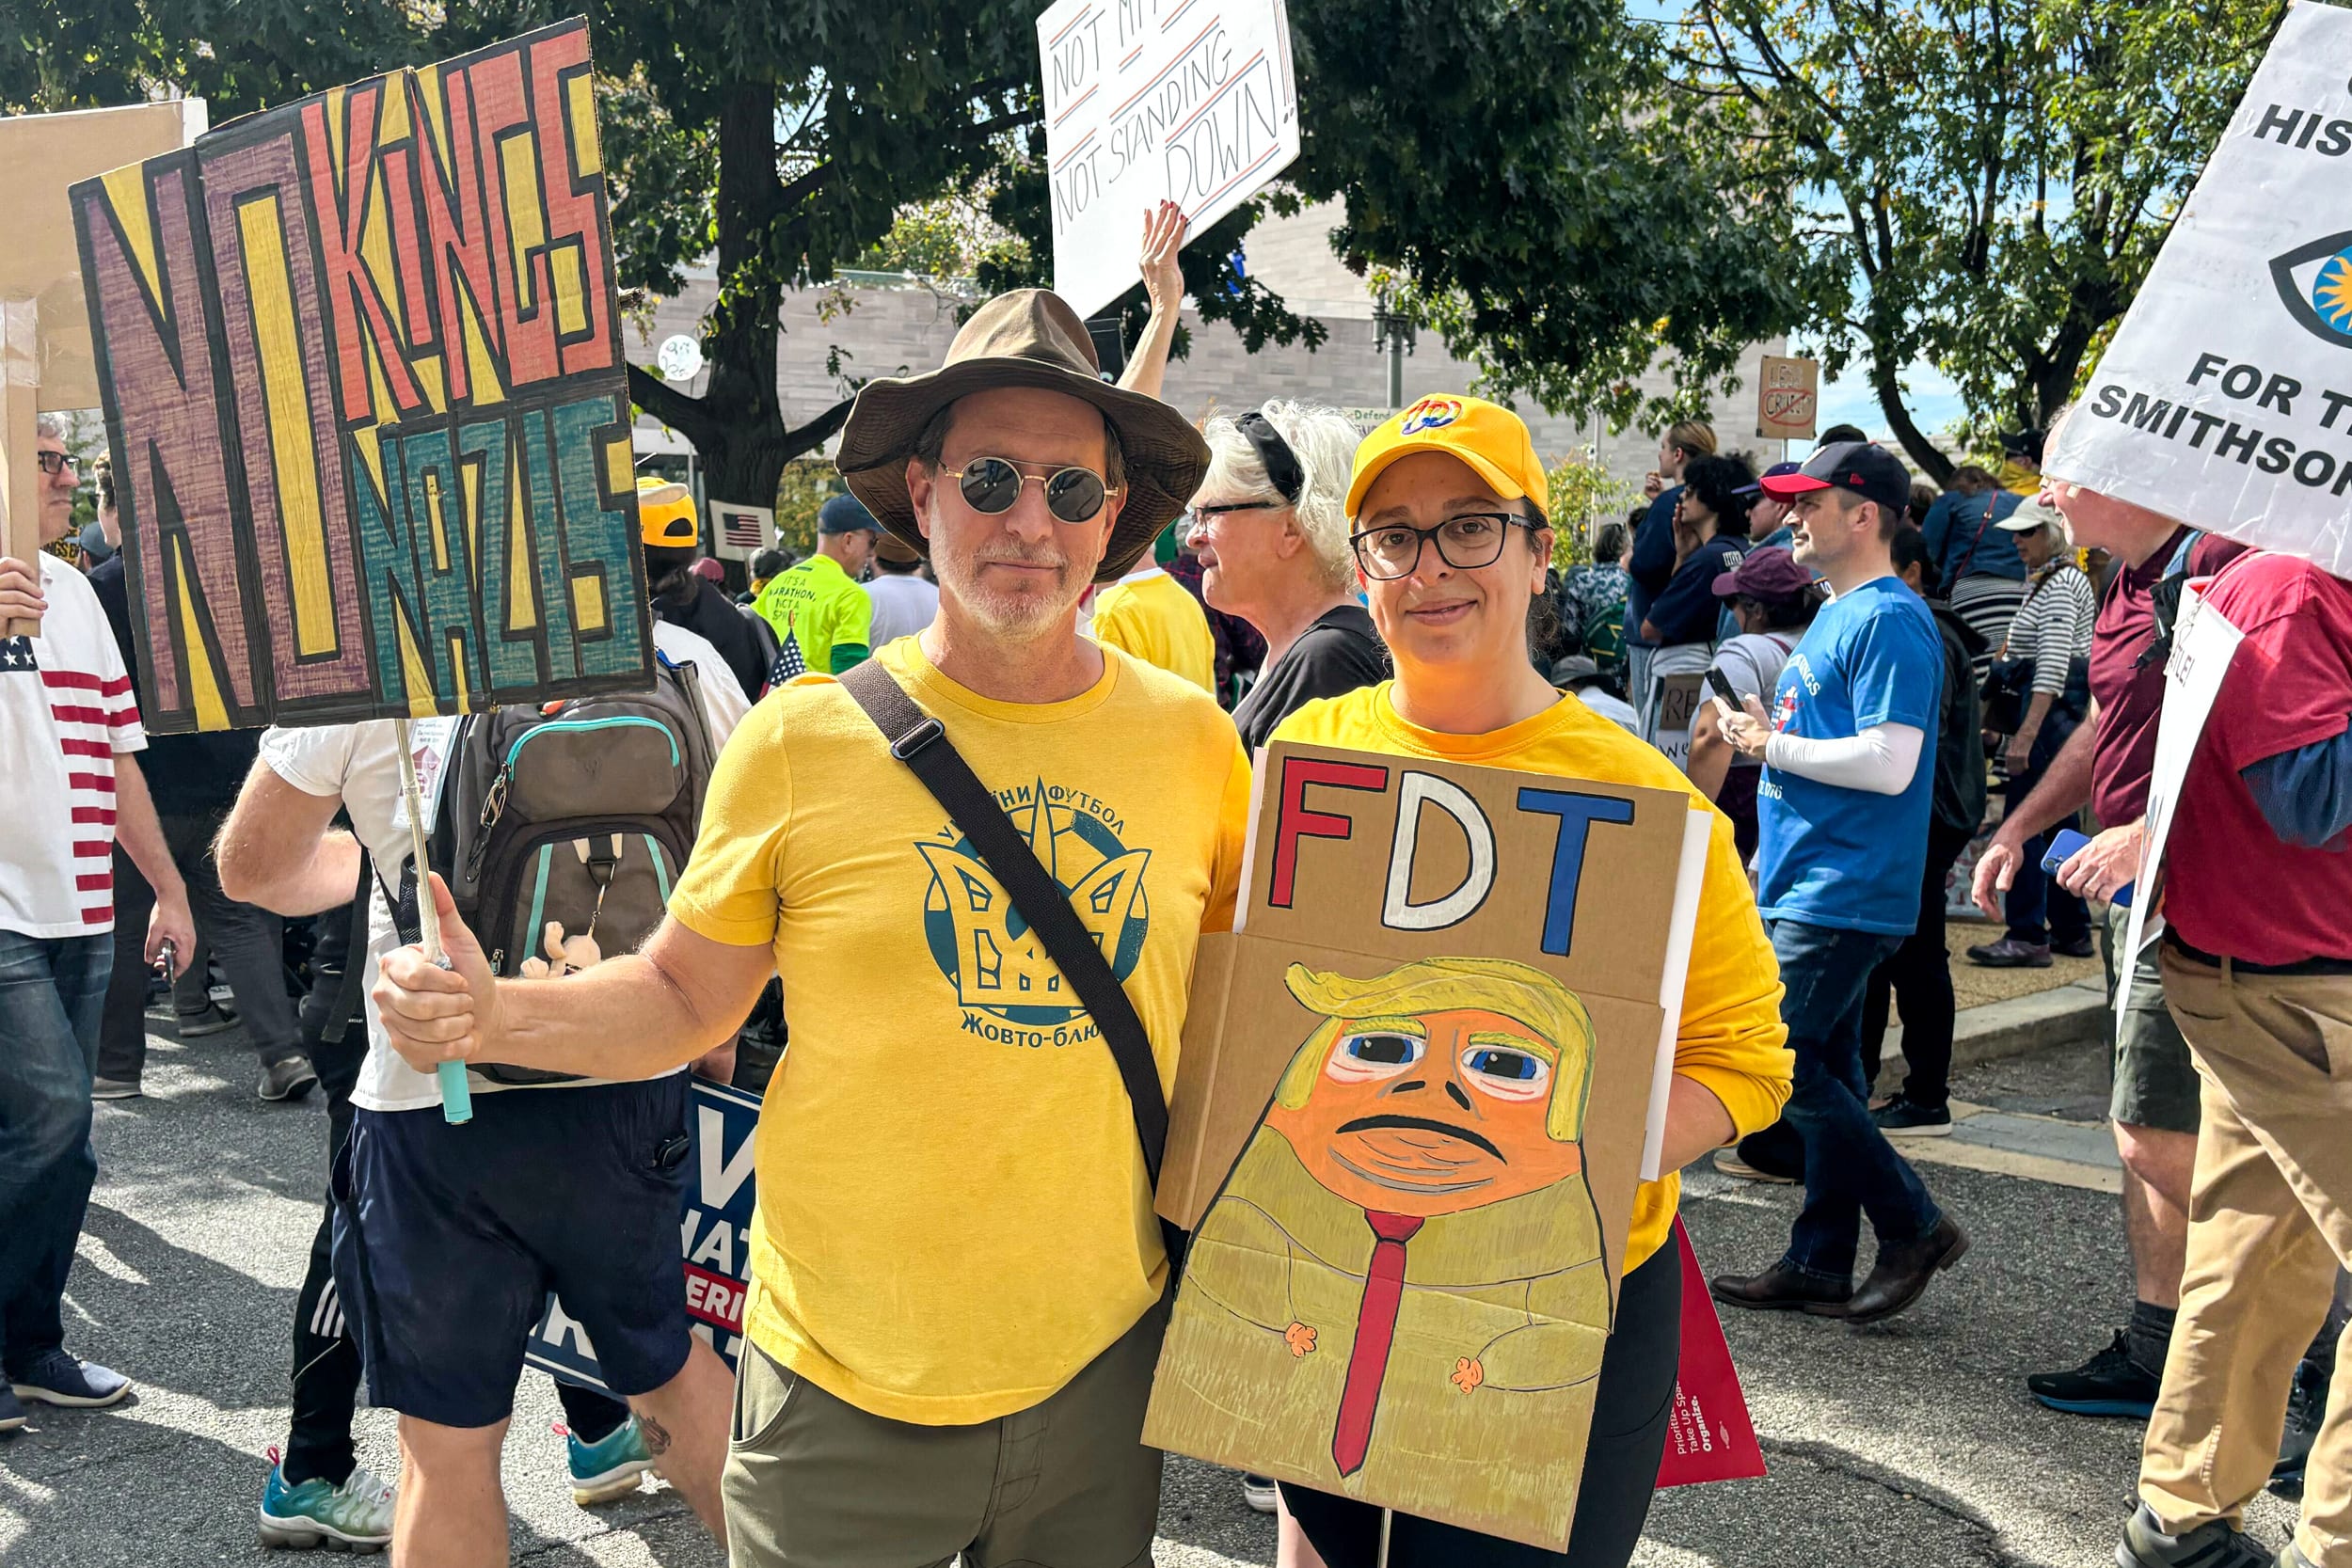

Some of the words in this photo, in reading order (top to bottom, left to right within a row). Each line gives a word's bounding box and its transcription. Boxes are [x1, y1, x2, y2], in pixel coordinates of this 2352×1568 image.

[1054, 9, 1105, 109] NOT
[1056, 144, 1102, 235] NOT
[1108, 29, 1232, 183] STANDING
[300, 28, 614, 422] KINGS
[85, 134, 373, 711] NO
[2185, 352, 2302, 416] FOR
[2319, 389, 2352, 436] T
[1048, 784, 1125, 835] ФУТБОЛ
[1268, 755, 1635, 958] FDT
[1676, 1380, 1687, 1408] Spa
[1680, 1409, 1692, 1426] Up
[1691, 1395, 1712, 1452] Organize.
[1670, 1406, 1687, 1455] Prioritiz
[1686, 1427, 1700, 1454] Take
